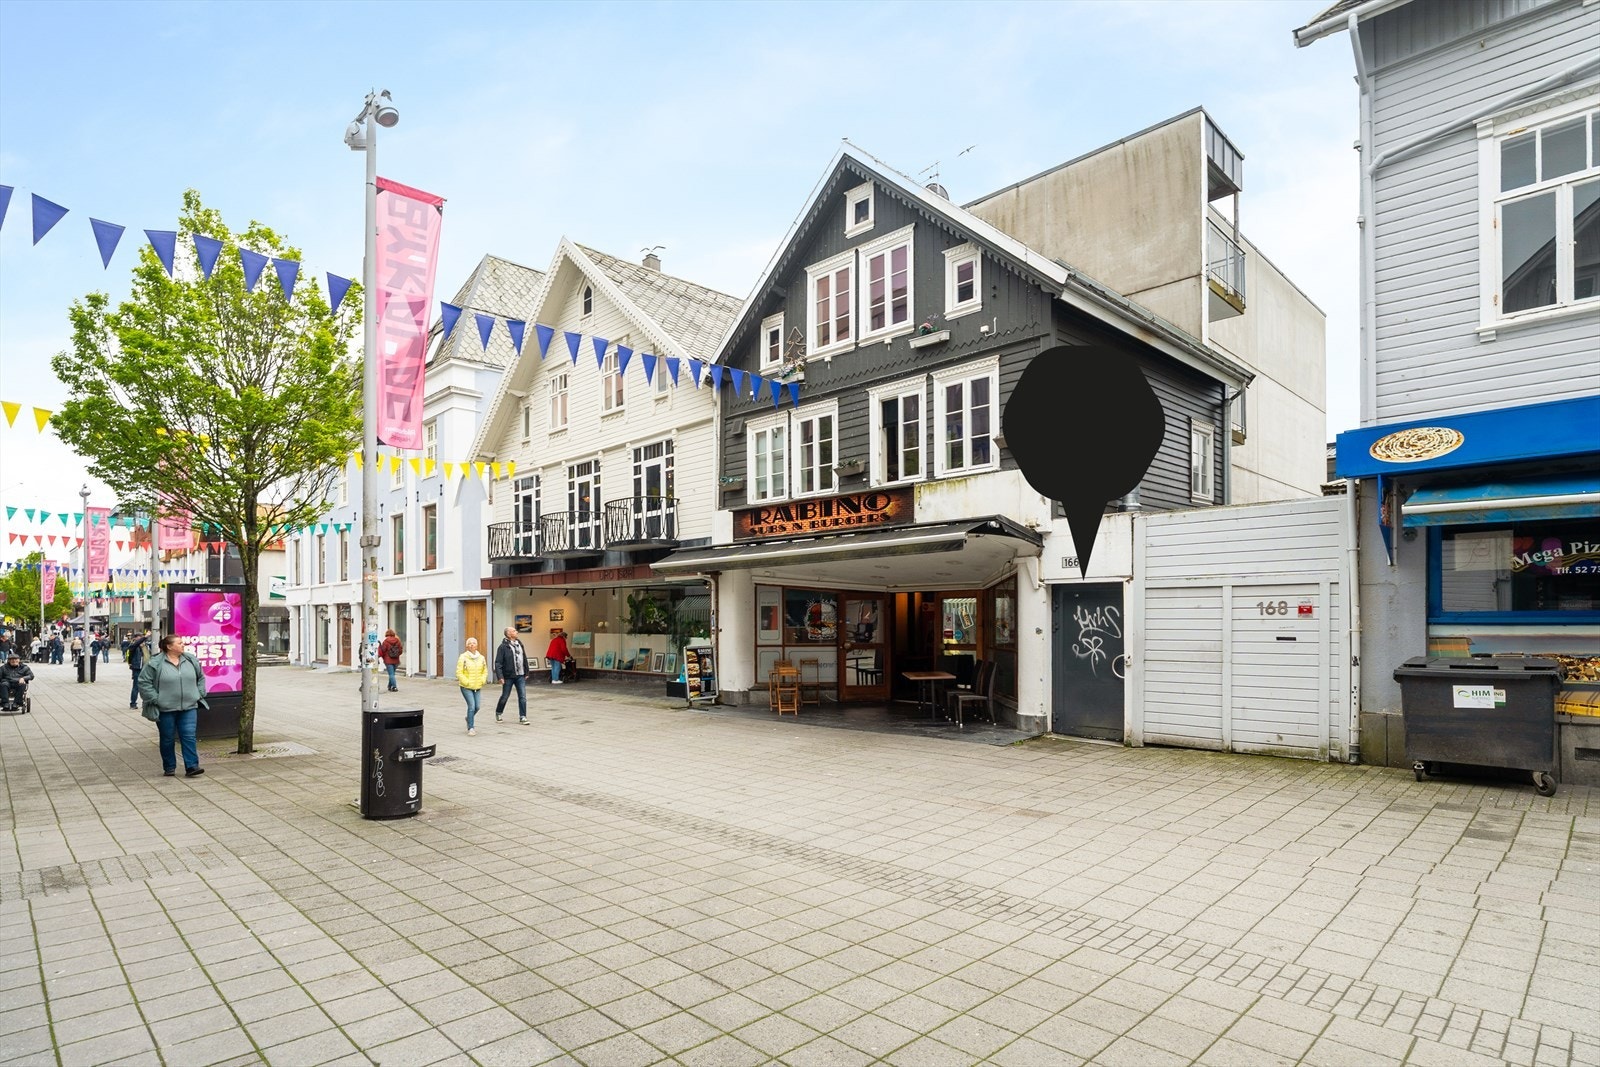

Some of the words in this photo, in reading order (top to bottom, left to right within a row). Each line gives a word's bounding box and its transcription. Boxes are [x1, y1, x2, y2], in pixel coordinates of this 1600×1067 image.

[750, 493, 891, 525] RABINO
[749, 524, 786, 535] SUBS
[809, 512, 891, 528] BURGERS
[1512, 547, 1564, 568] Mega
[1257, 601, 1288, 615] 168
[209, 657, 236, 666] LÅTER
